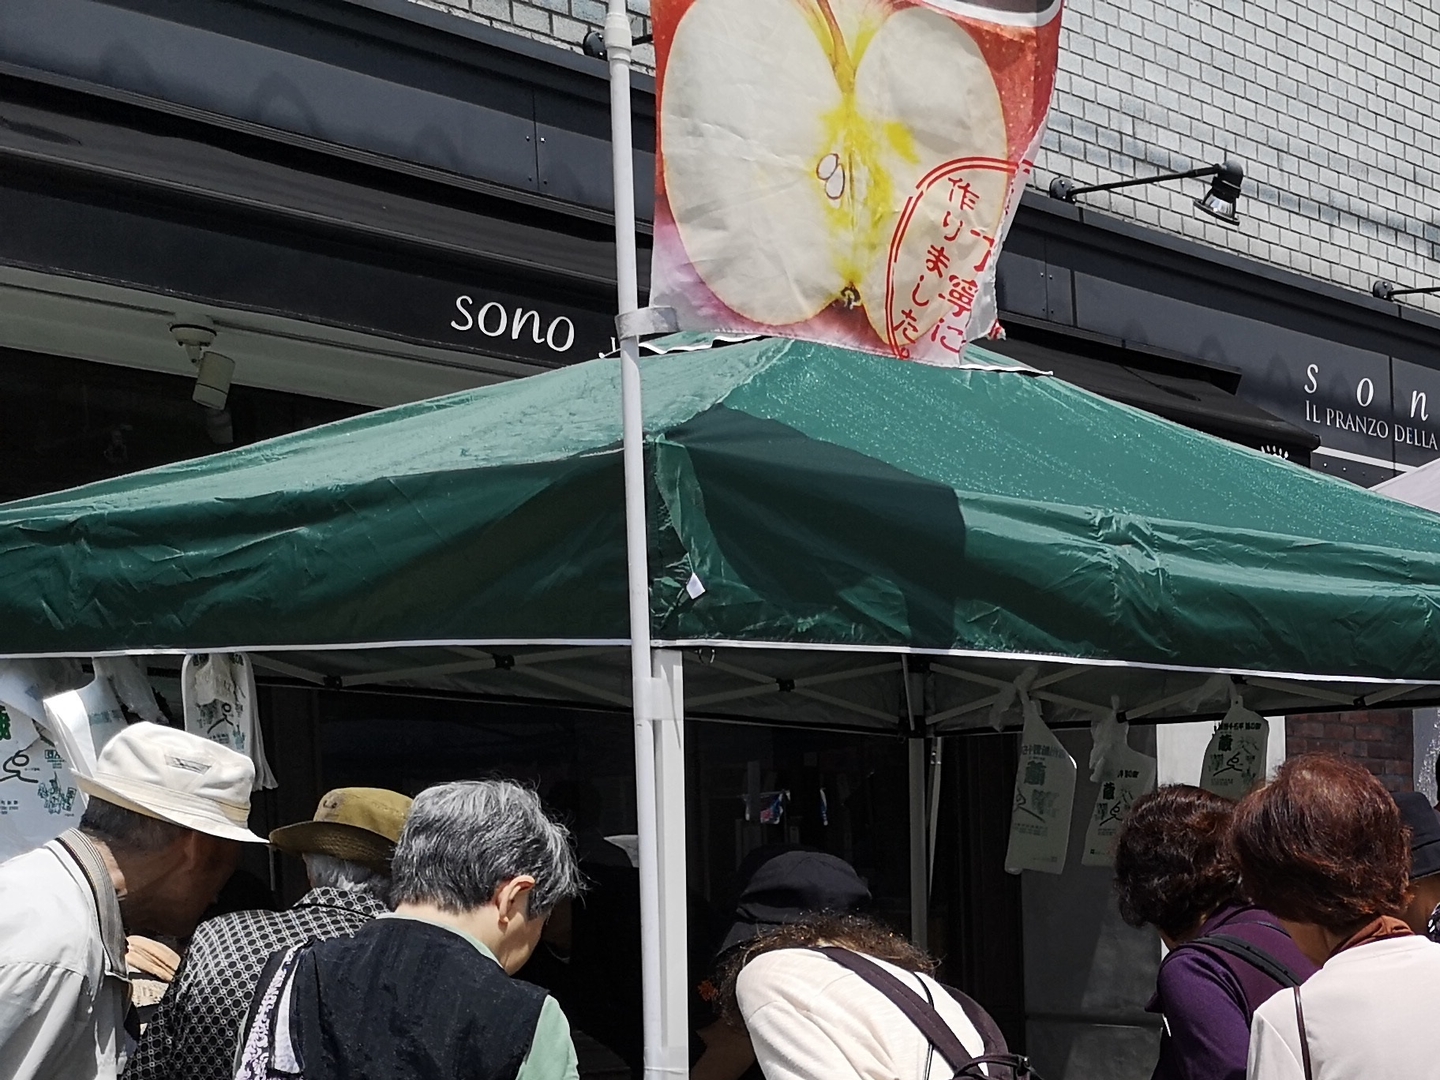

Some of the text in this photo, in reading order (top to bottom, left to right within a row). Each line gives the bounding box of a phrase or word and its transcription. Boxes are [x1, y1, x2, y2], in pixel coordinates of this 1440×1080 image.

[450, 295, 576, 352] sono
[1305, 400, 1321, 424] IL
[1326, 408, 1389, 439] PRANZO
[1394, 424, 1437, 451] DELLA
